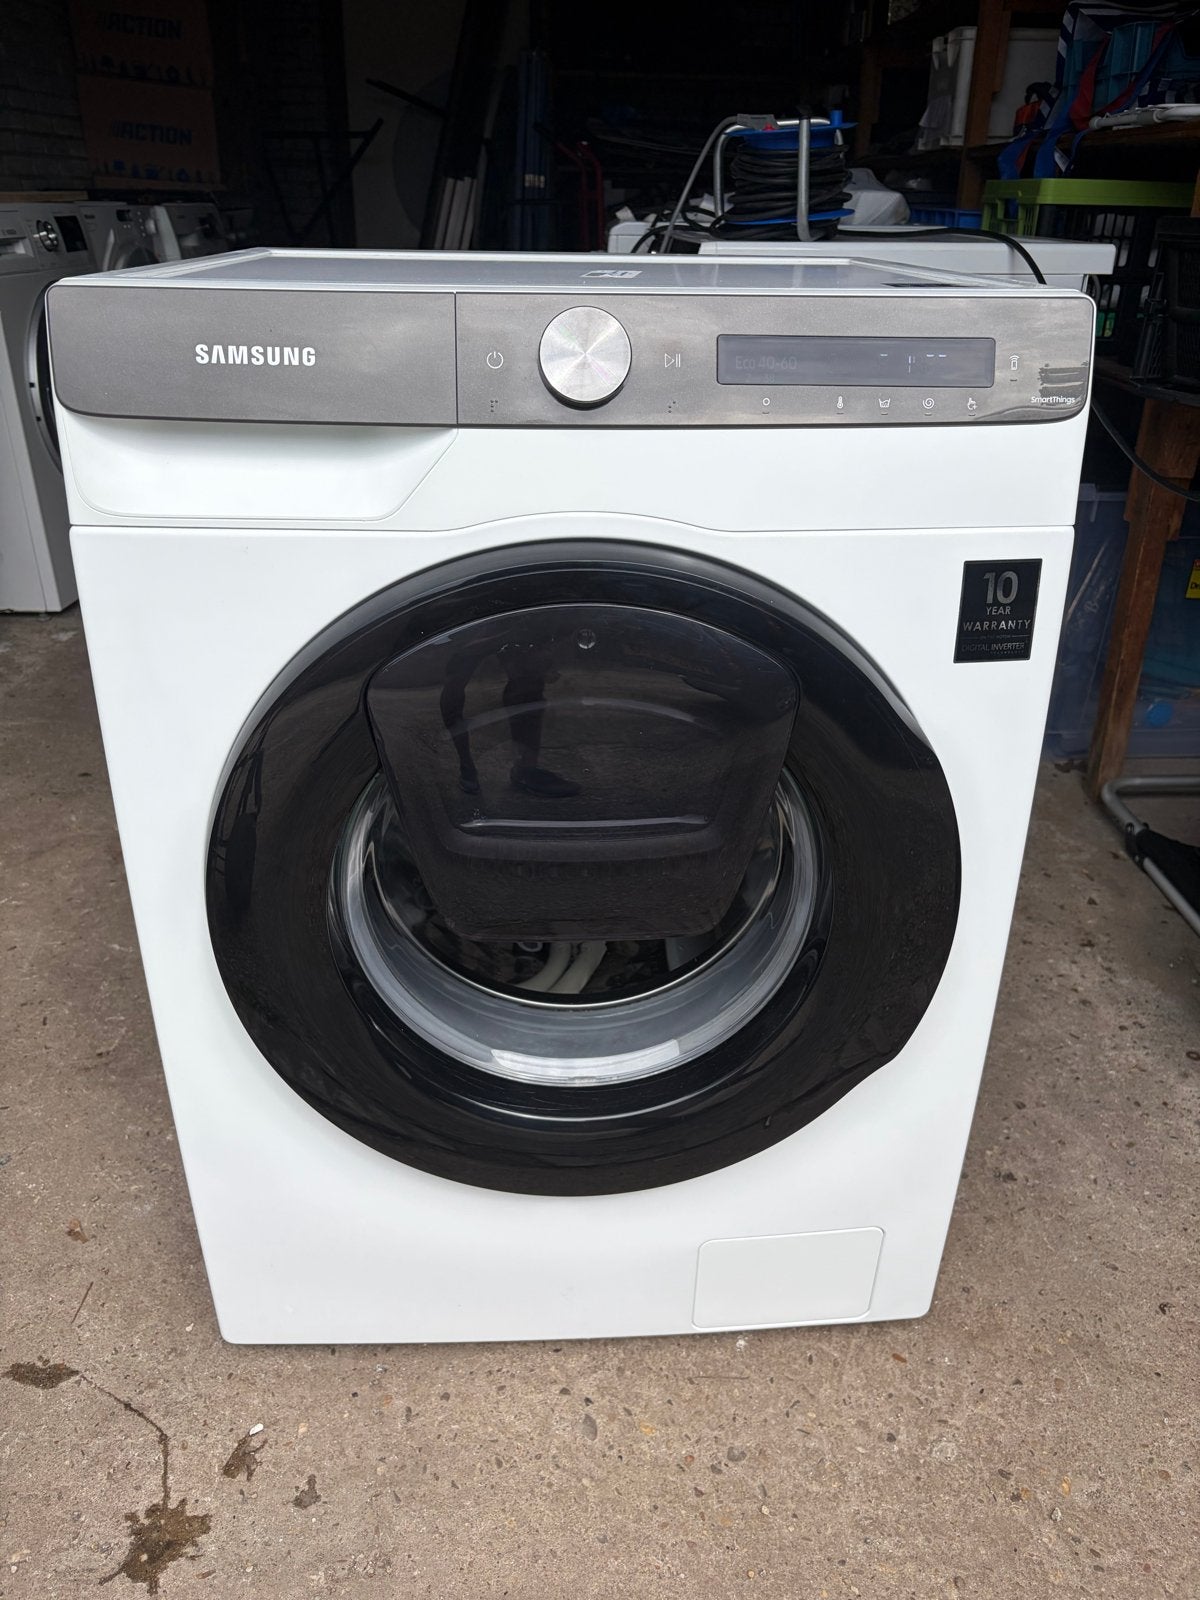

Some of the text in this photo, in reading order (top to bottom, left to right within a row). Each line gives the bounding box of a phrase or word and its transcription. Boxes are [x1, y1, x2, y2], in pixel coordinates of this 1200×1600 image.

[119, 121, 192, 145] ACTION
[195, 343, 317, 367] SAMSUNG
[735, 355, 797, 370] Eco 40-60
[1030, 396, 1075, 405] SmartThings
[983, 570, 1019, 605] 10
[986, 606, 1012, 616] YEAR
[963, 619, 1031, 631] WARRANTY
[961, 642, 1025, 652] DIGITAL INVERTER
